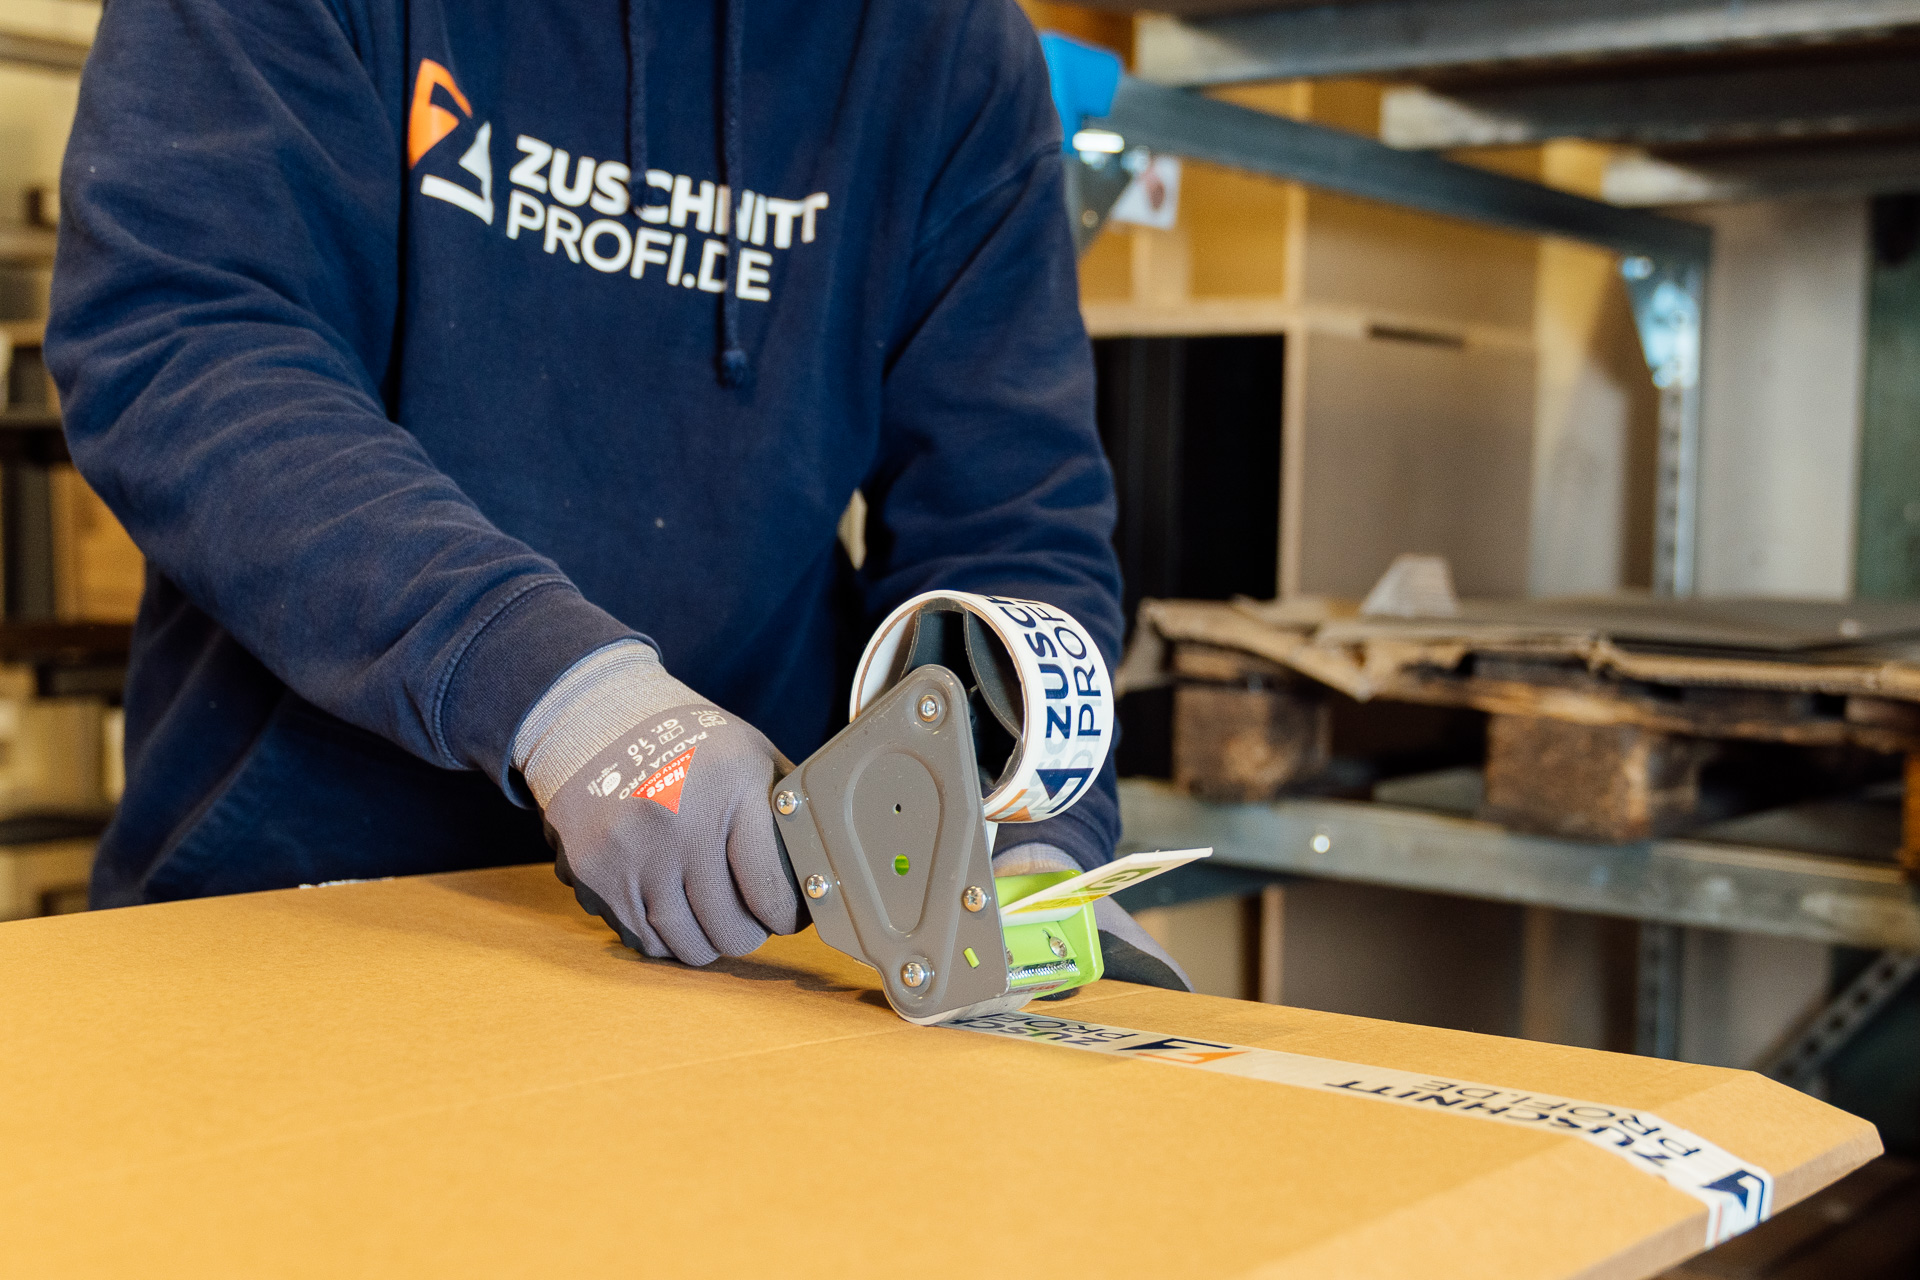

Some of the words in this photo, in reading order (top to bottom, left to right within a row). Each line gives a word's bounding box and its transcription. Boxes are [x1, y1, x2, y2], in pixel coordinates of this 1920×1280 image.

[506, 189, 772, 301] PROFI.DE
[651, 718, 679, 734] Gr.
[627, 738, 649, 757] 10
[649, 731, 708, 769] PADUA
[662, 753, 691, 775] Safety
[618, 769, 647, 800] PRO
[636, 772, 662, 795] gloves
[646, 766, 685, 798] Hase
[1323, 1080, 1672, 1167] ZUSCHNITT
[1412, 1079, 1701, 1158] PROFI.DE
